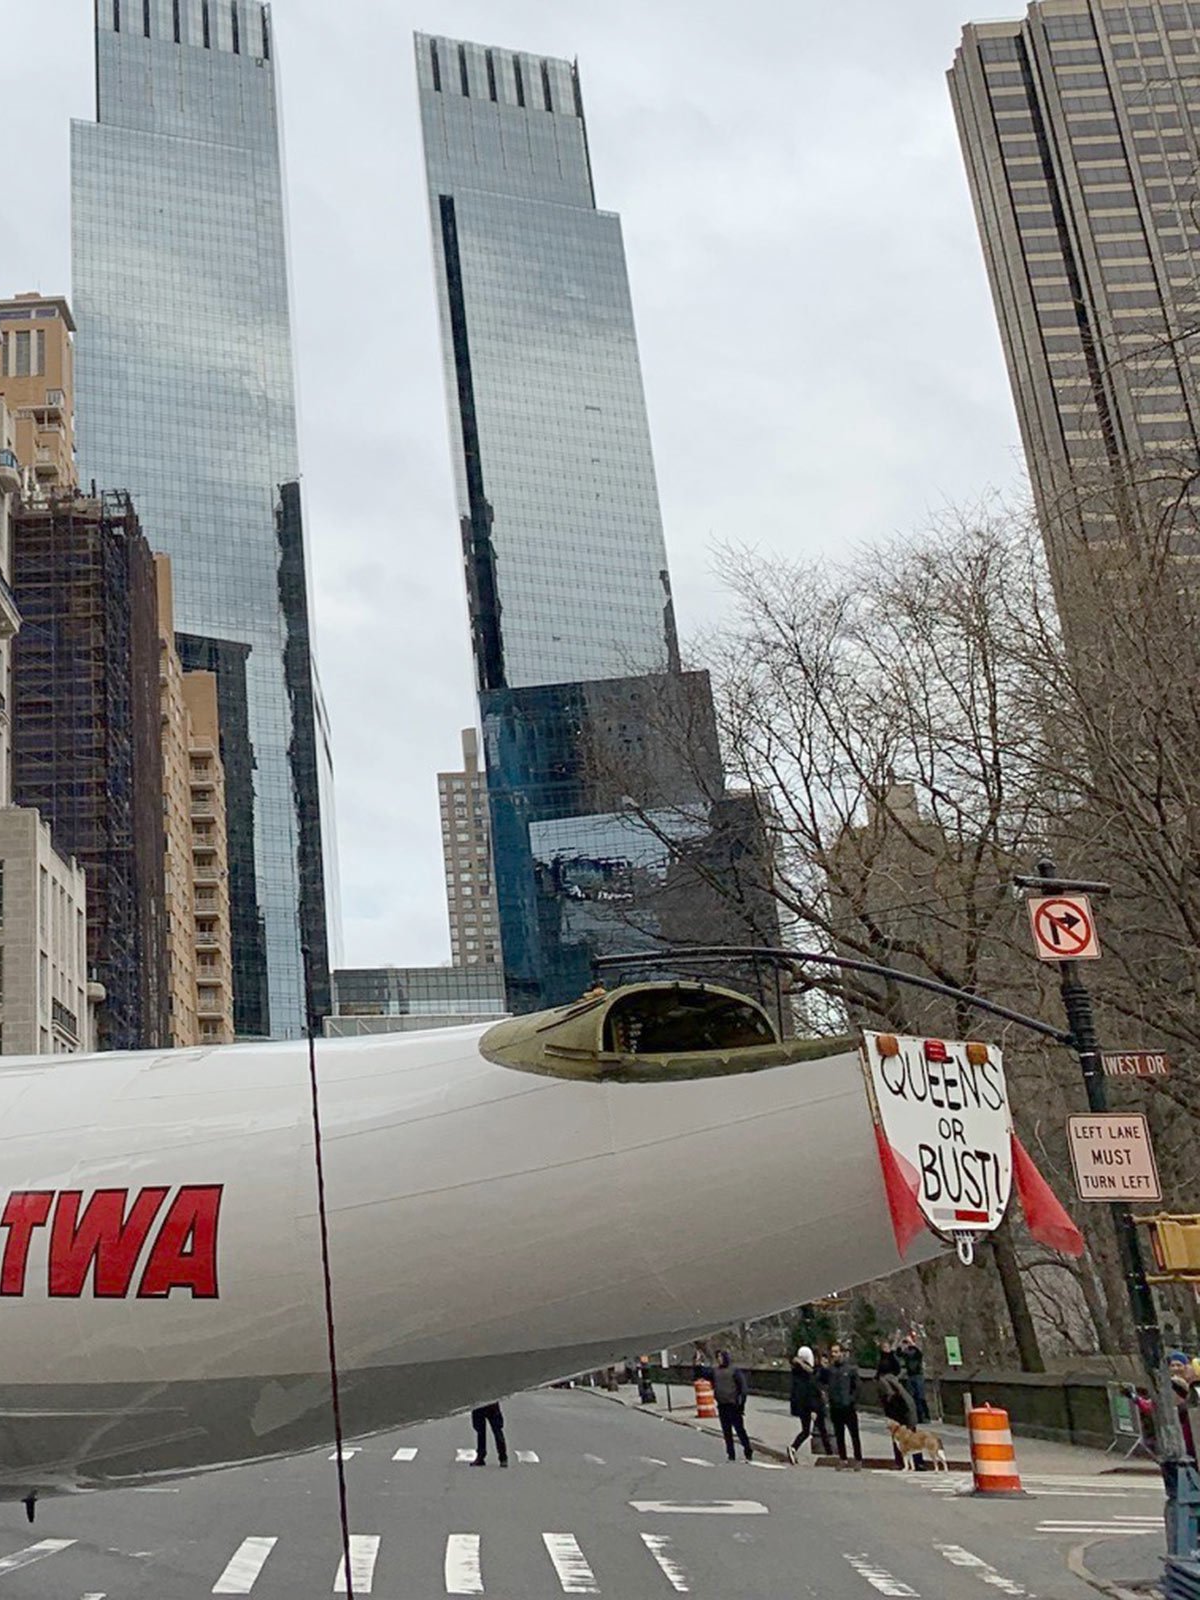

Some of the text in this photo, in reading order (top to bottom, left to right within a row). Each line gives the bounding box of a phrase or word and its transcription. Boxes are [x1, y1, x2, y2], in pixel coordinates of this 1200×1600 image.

[1104, 1055, 1167, 1077] WEST DR
[880, 1051, 1005, 1110] QUEENS
[938, 1118, 966, 1144] OR
[1074, 1126, 1141, 1140] LEFT LANE
[1091, 1149, 1132, 1166] MUST
[919, 1144, 1004, 1214] BUST!
[1083, 1175, 1151, 1189] TURN LEFT
[0, 1183, 224, 1299] TWA
